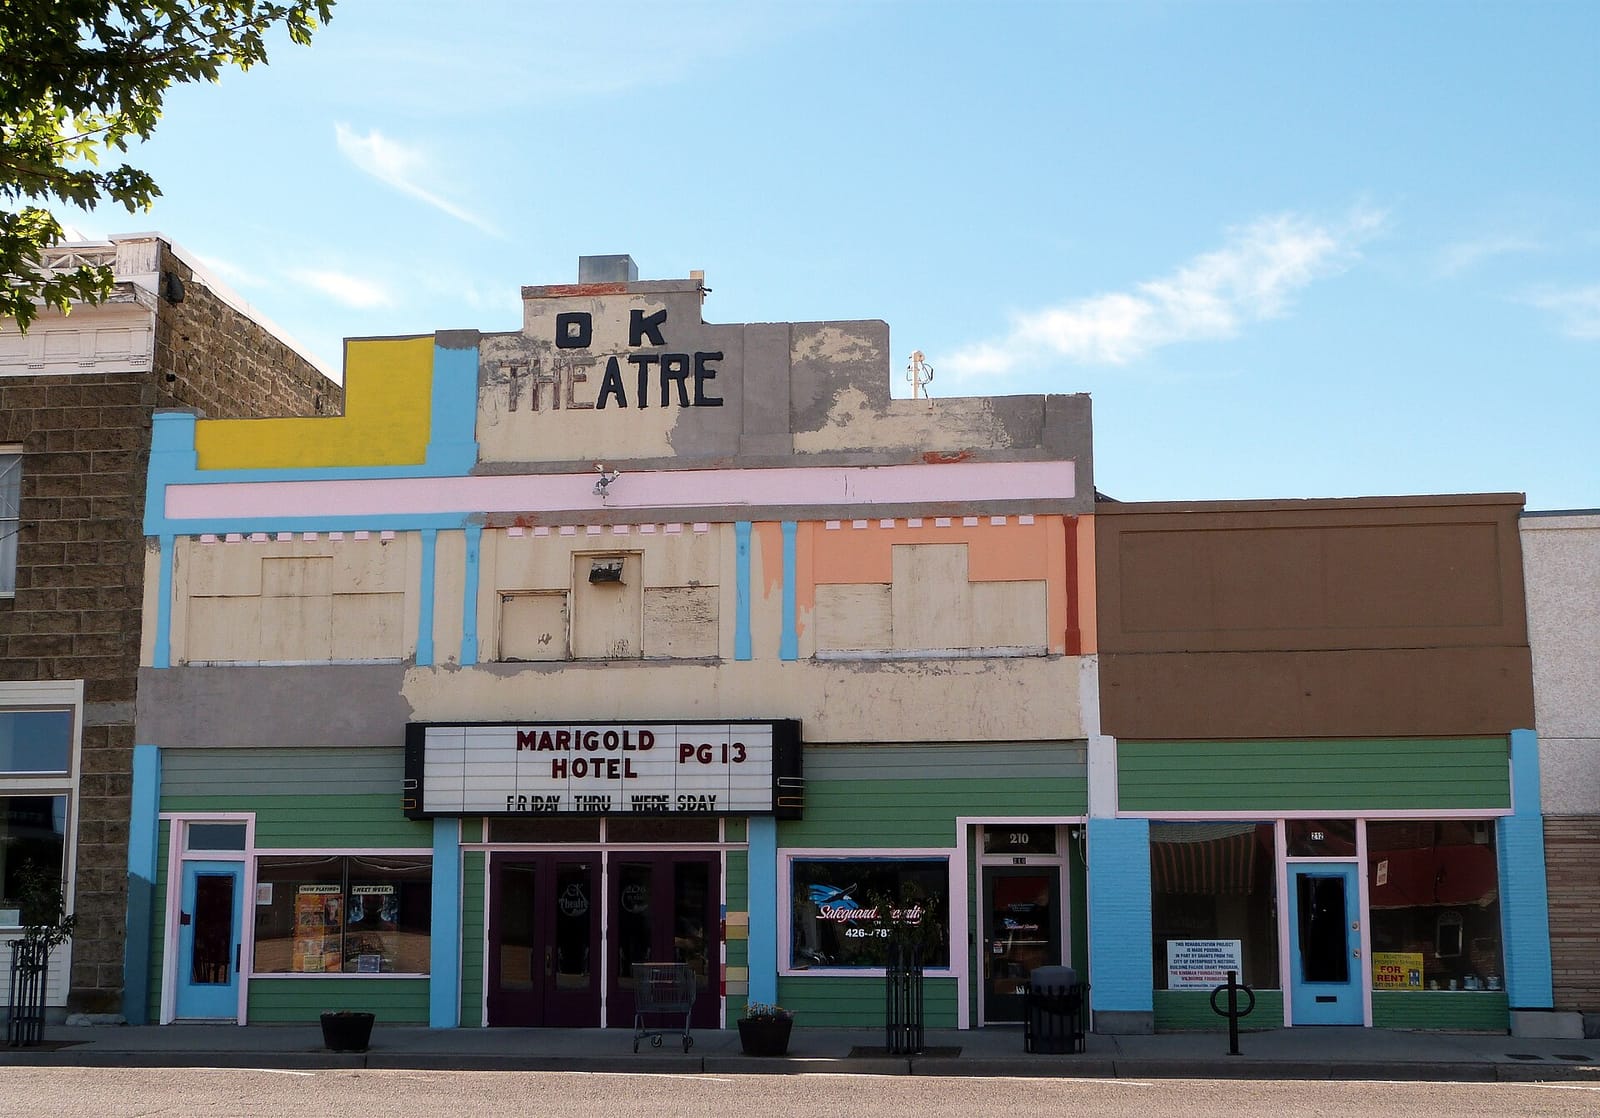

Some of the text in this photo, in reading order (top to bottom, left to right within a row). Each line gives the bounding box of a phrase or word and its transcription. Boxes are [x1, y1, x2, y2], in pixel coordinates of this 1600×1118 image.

[500, 352, 724, 412] THEATRE
[516, 730, 655, 751] MARIGOLD
[551, 757, 638, 779] HOTEL
[574, 795, 611, 811] THRU
[1009, 833, 1029, 844] 210
[816, 905, 878, 923] Safeguard
